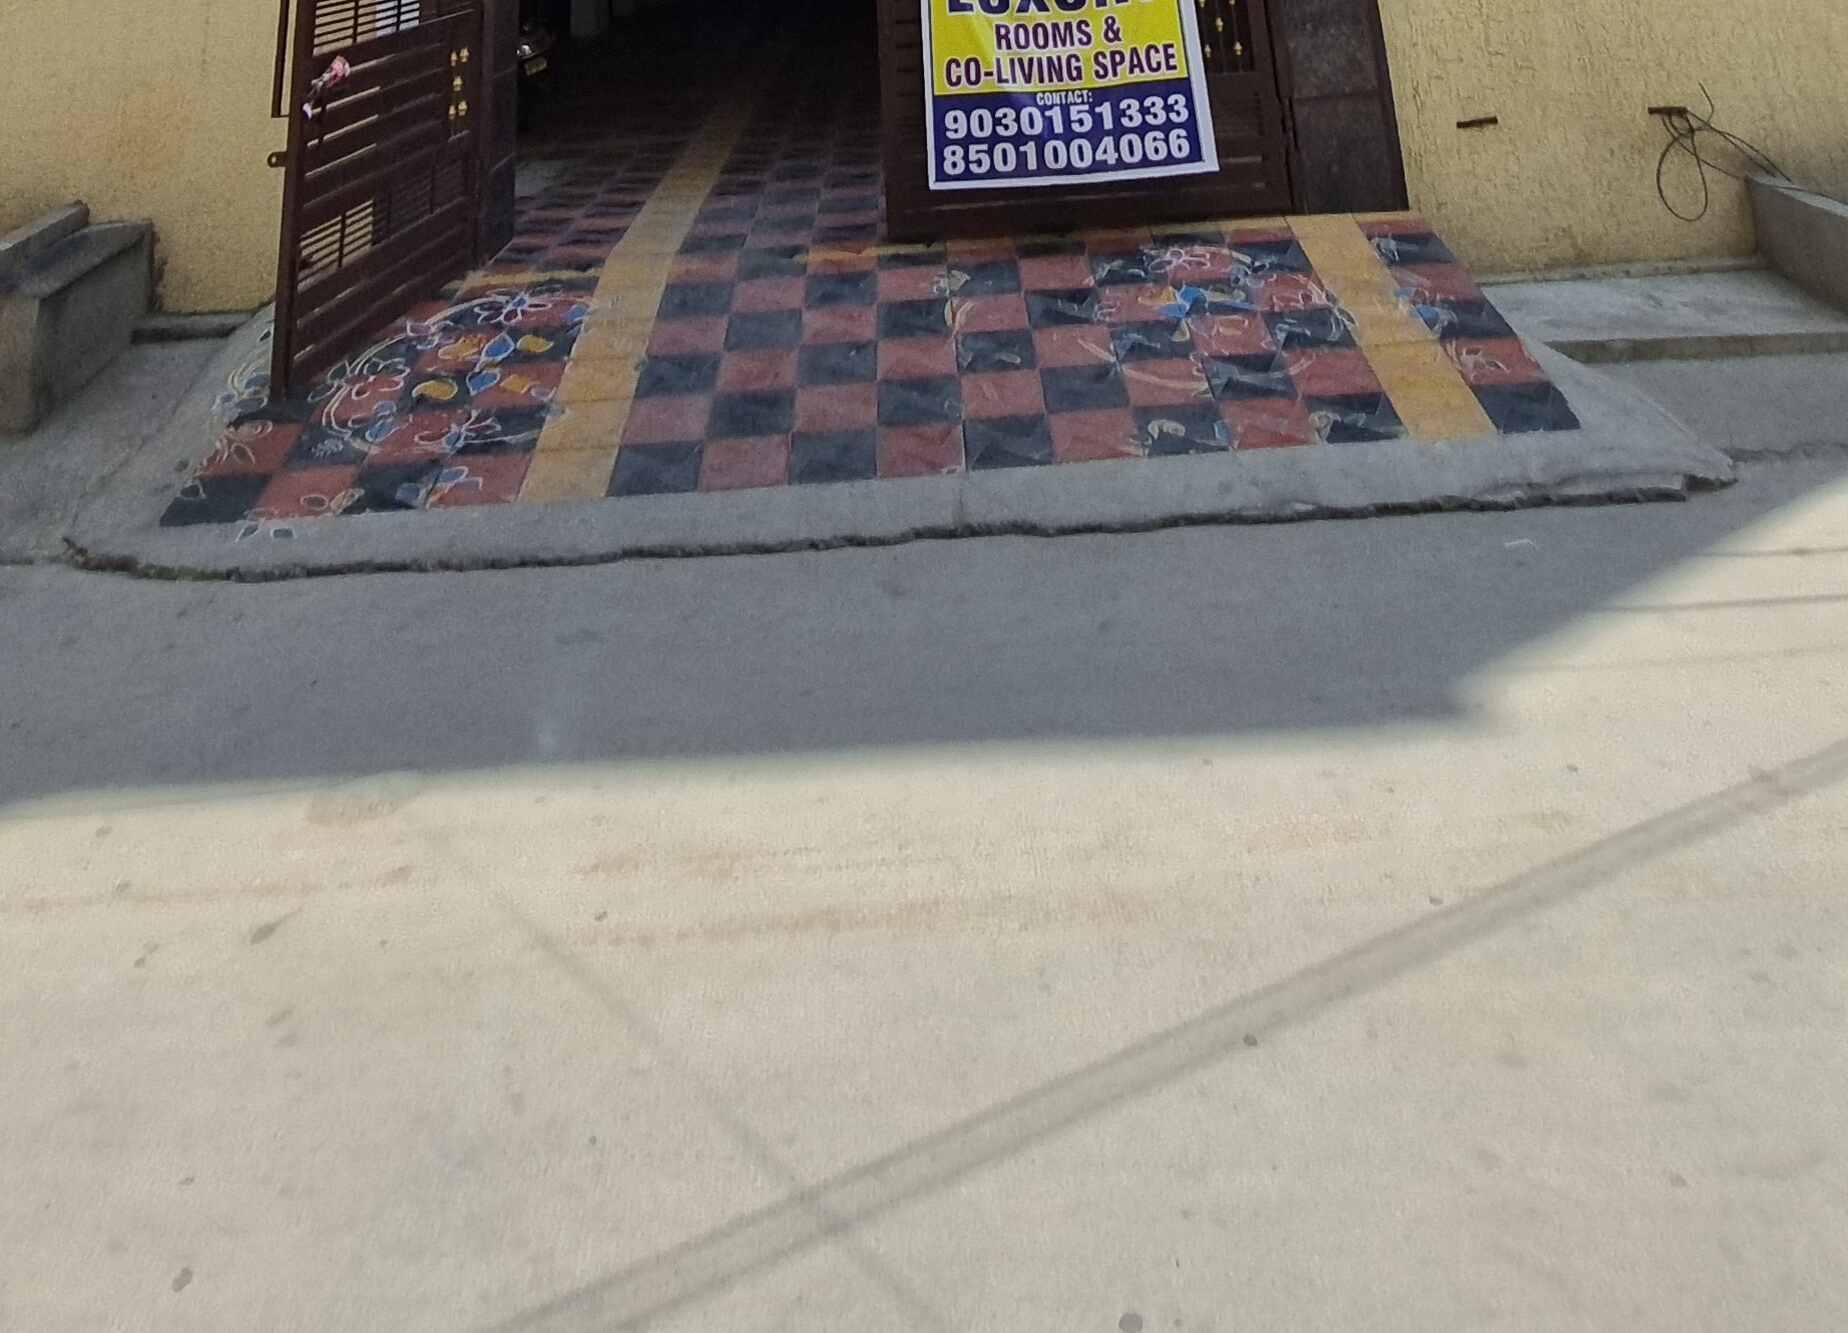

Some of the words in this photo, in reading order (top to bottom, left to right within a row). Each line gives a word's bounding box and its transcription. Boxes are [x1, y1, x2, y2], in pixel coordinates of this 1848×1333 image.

[994, 19, 1093, 51] ROOMS
[1102, 15, 1122, 44] &
[945, 53, 1083, 87] CO-LIVING
[1093, 43, 1178, 80] SPACE
[944, 94, 1190, 140] 9030151333
[1035, 90, 1094, 105] CONTACT:
[942, 128, 1191, 176] 8501004066
